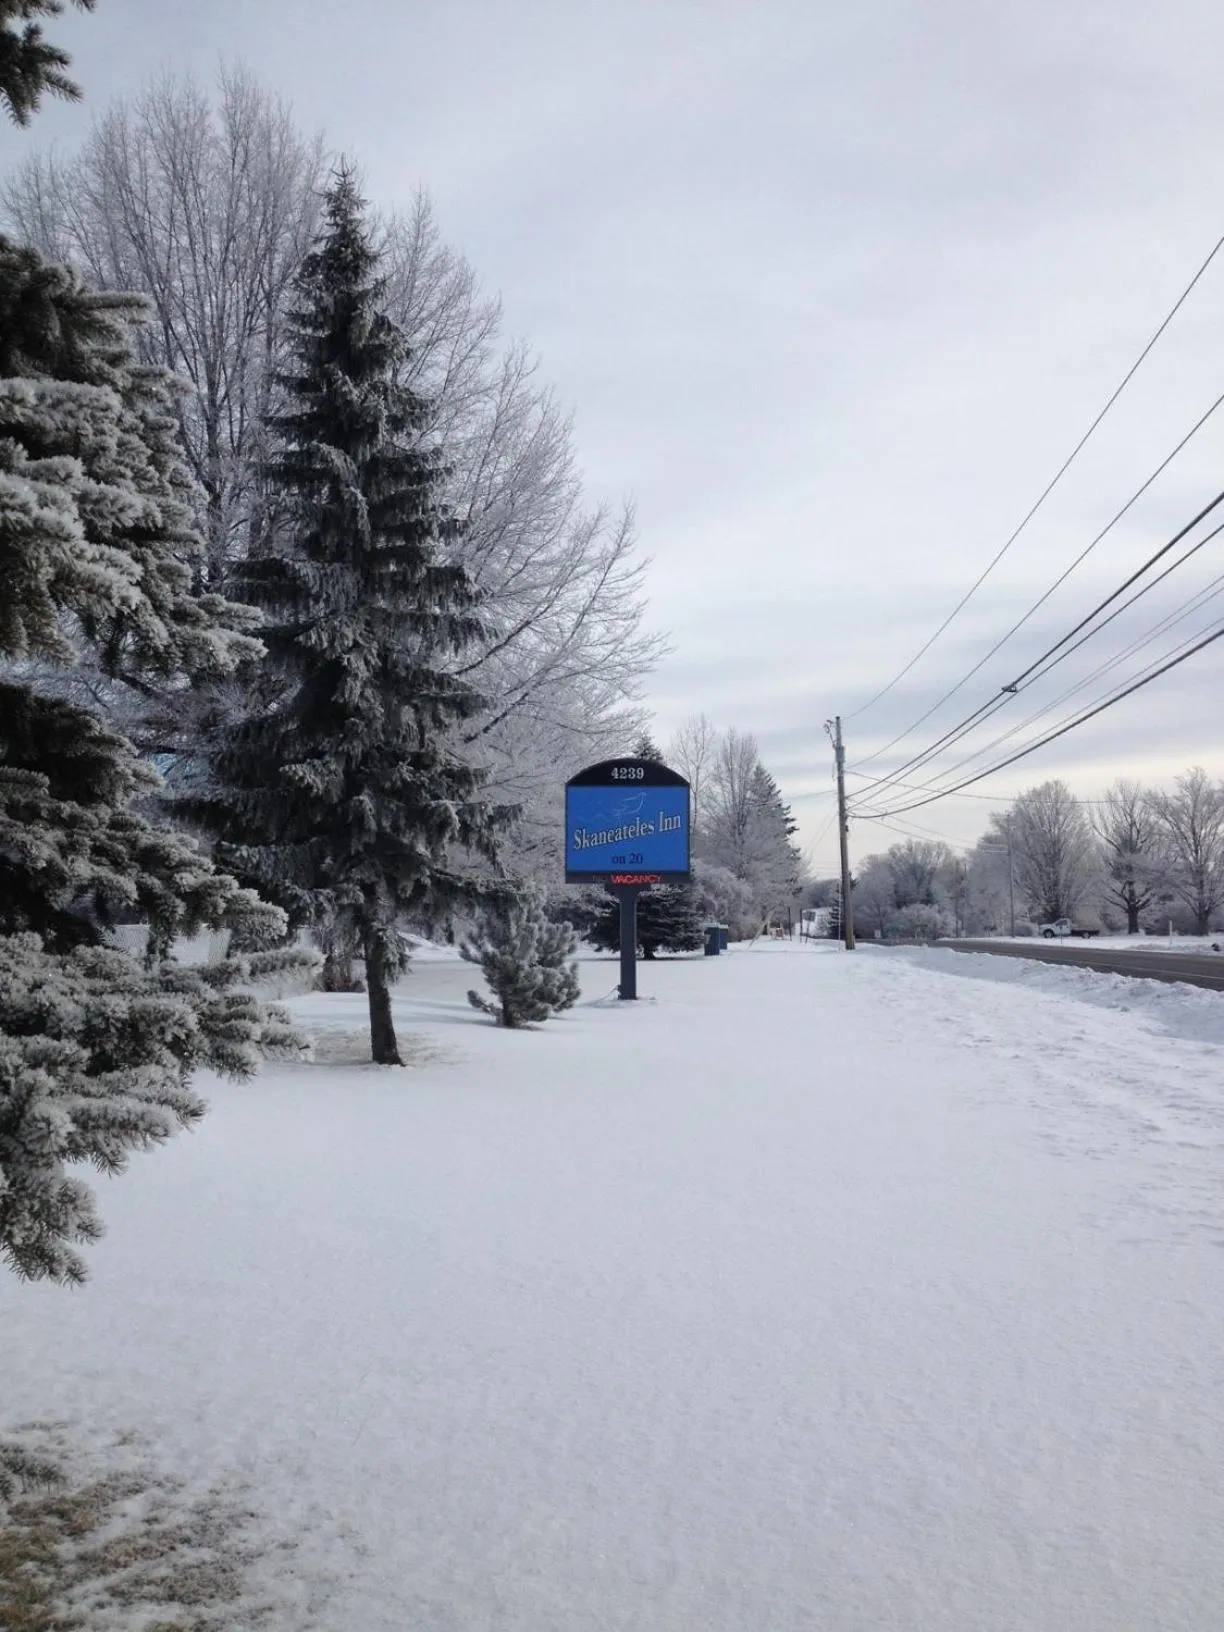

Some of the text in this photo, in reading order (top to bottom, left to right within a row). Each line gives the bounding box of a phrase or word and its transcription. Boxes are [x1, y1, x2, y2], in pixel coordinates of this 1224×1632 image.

[611, 767, 645, 779] 4239
[573, 811, 681, 850] Skaneateles Inn
[611, 853, 643, 865] on 20
[611, 874, 662, 884] VACANCY
